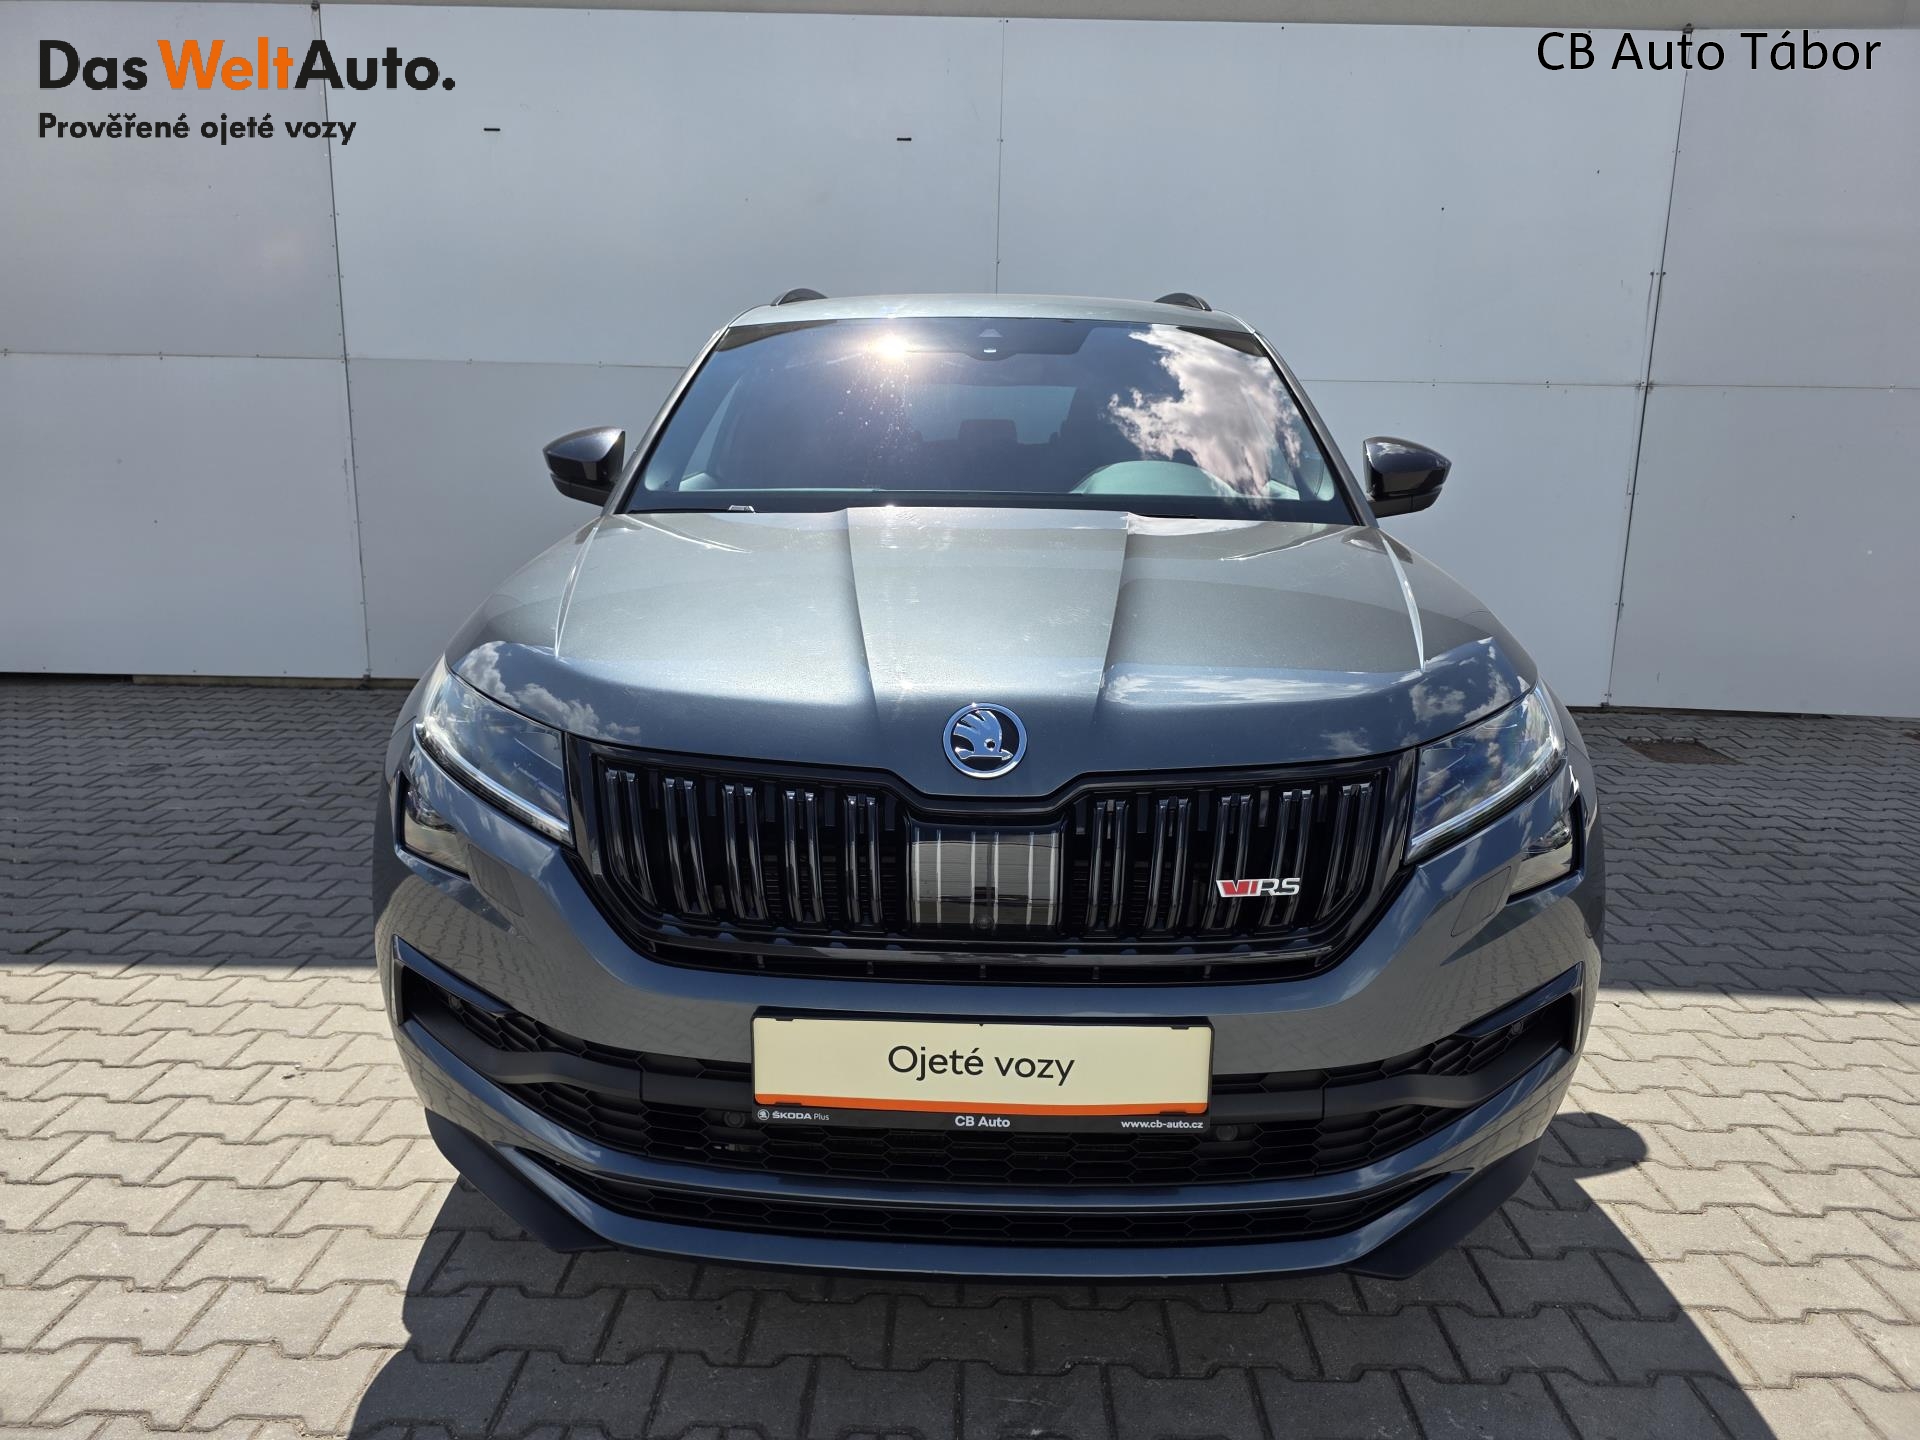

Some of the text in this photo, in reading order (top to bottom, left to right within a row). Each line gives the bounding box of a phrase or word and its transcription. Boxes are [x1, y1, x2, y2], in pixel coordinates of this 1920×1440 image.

[888, 1045, 1075, 1086] Ojeté vozy
[772, 1110, 830, 1121] ŠKODA Plus
[954, 1115, 1011, 1128] CB Auto
[1120, 1119, 1204, 1130] www.cb-auto.cz
